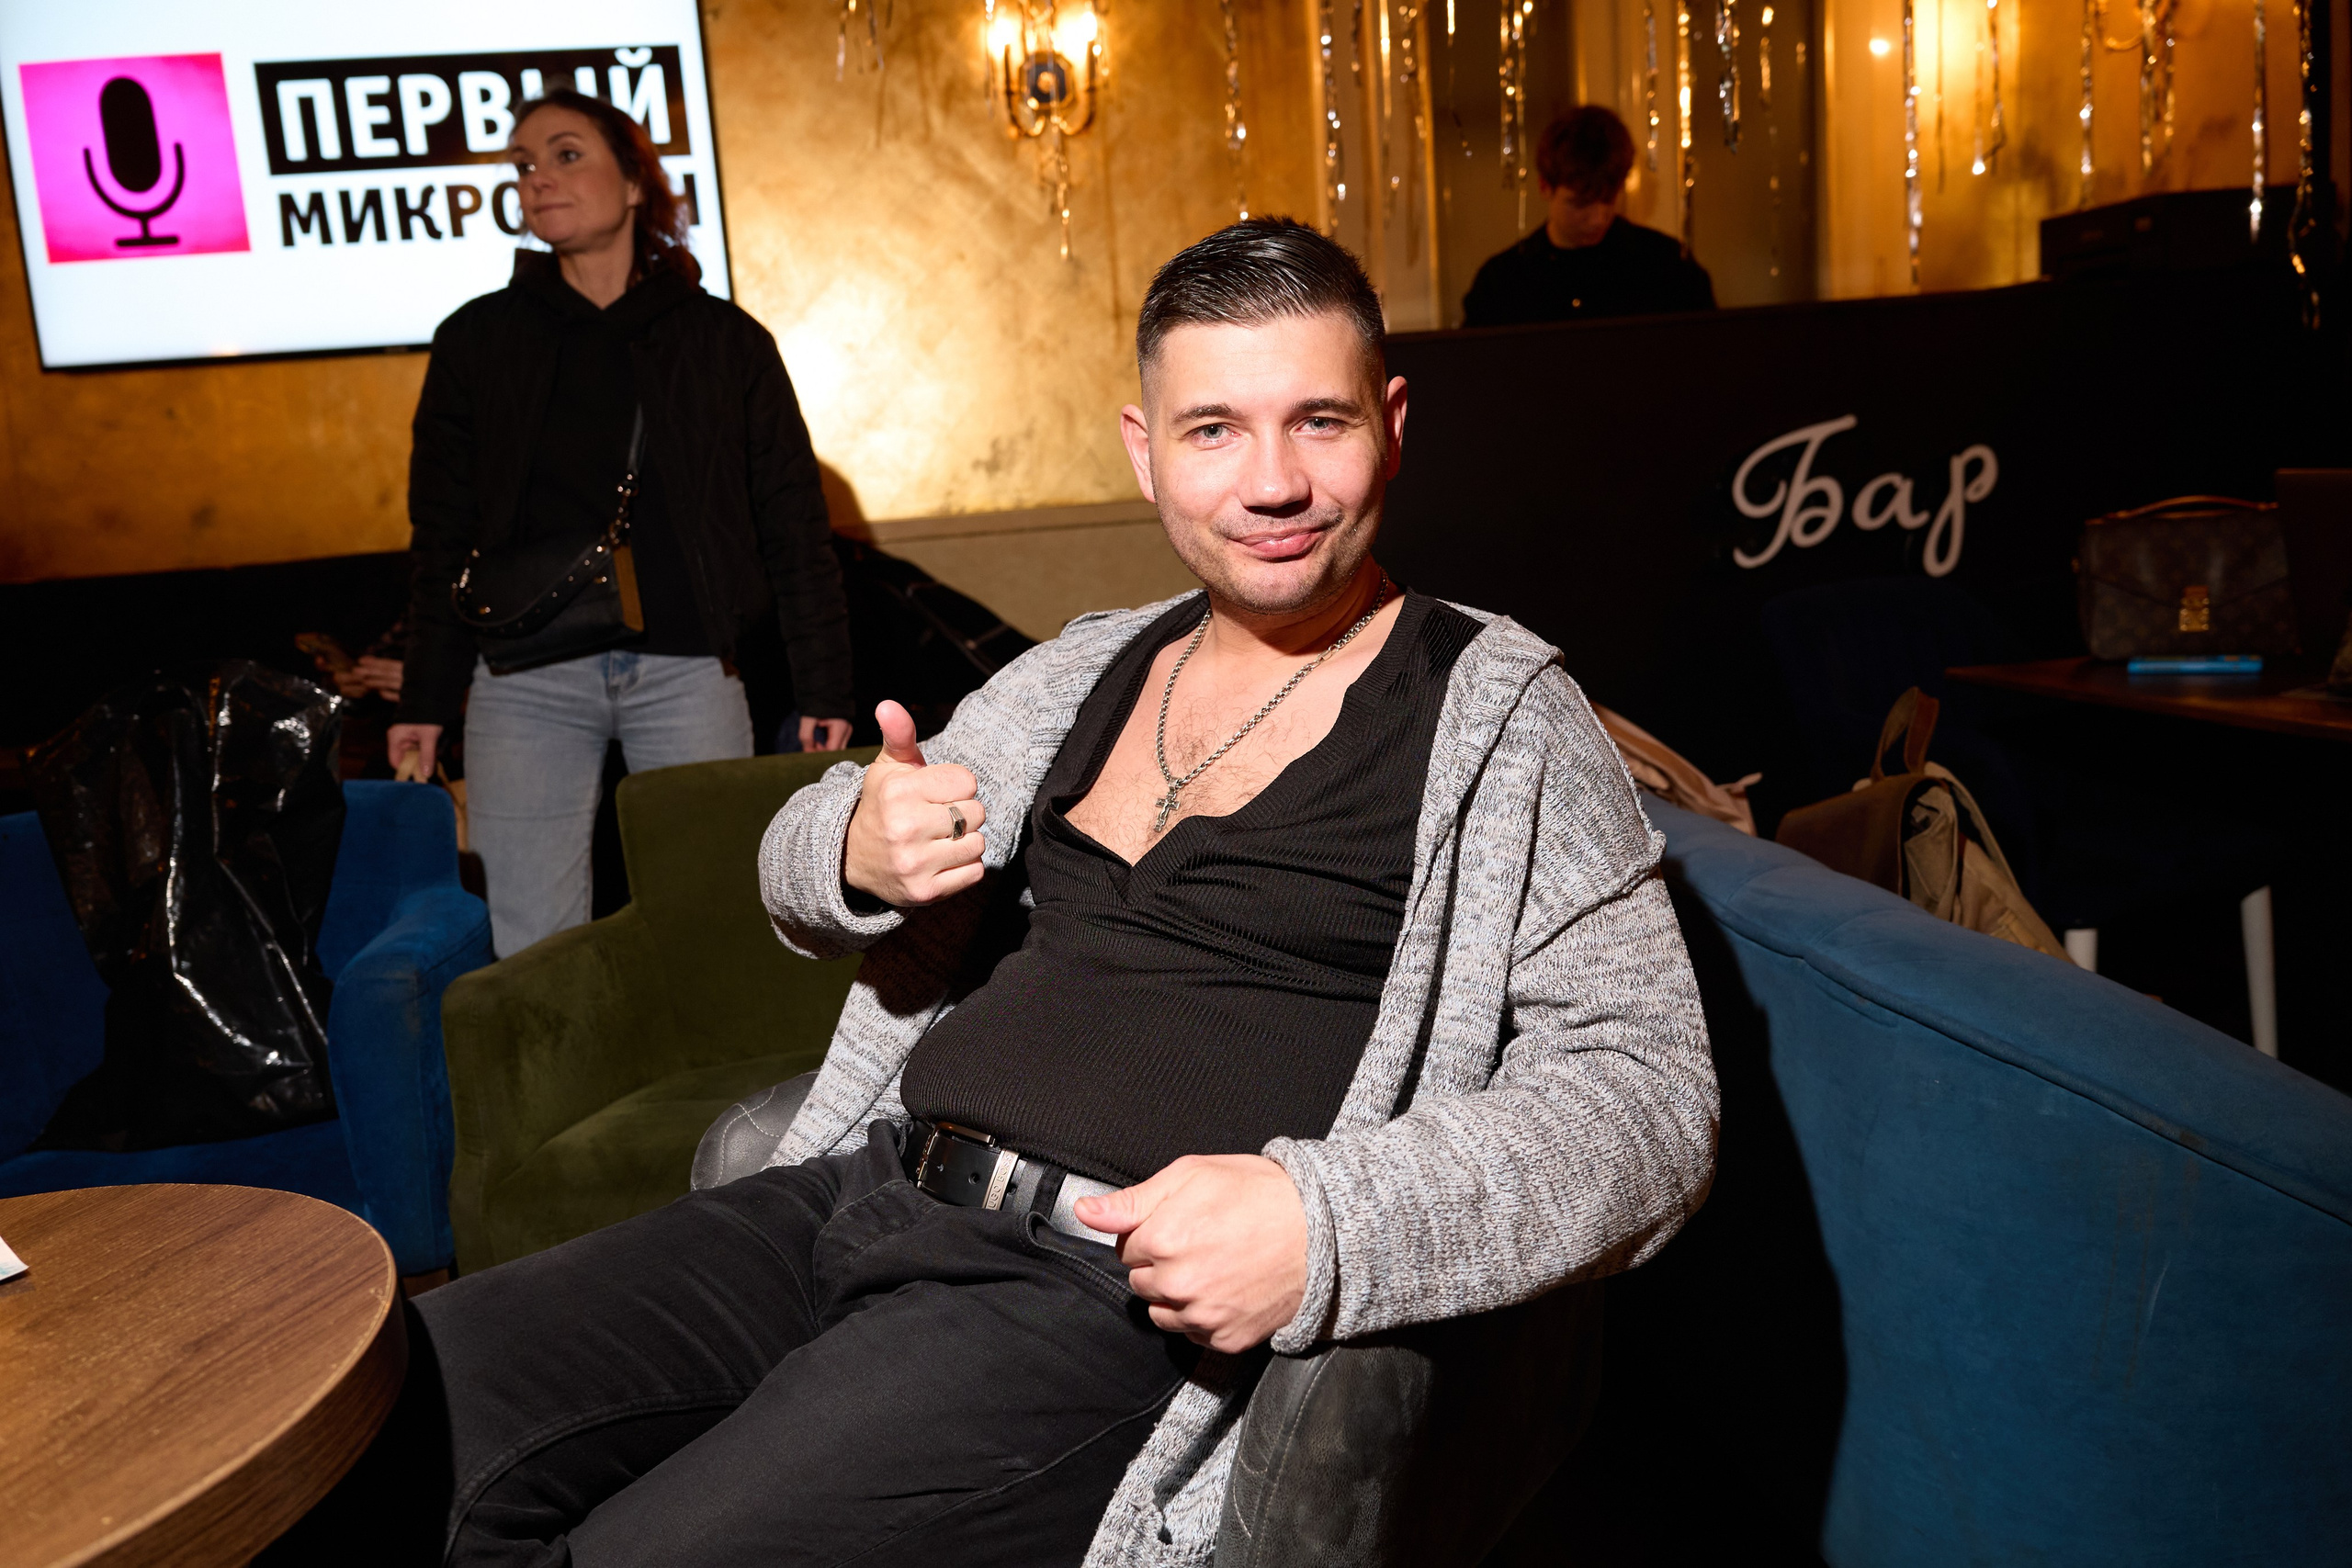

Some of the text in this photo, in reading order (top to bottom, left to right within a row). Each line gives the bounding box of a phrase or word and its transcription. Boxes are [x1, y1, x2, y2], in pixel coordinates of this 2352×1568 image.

[1732, 413, 1998, 578] Бар
[987, 1154, 1013, 1209] UGO BOSS
